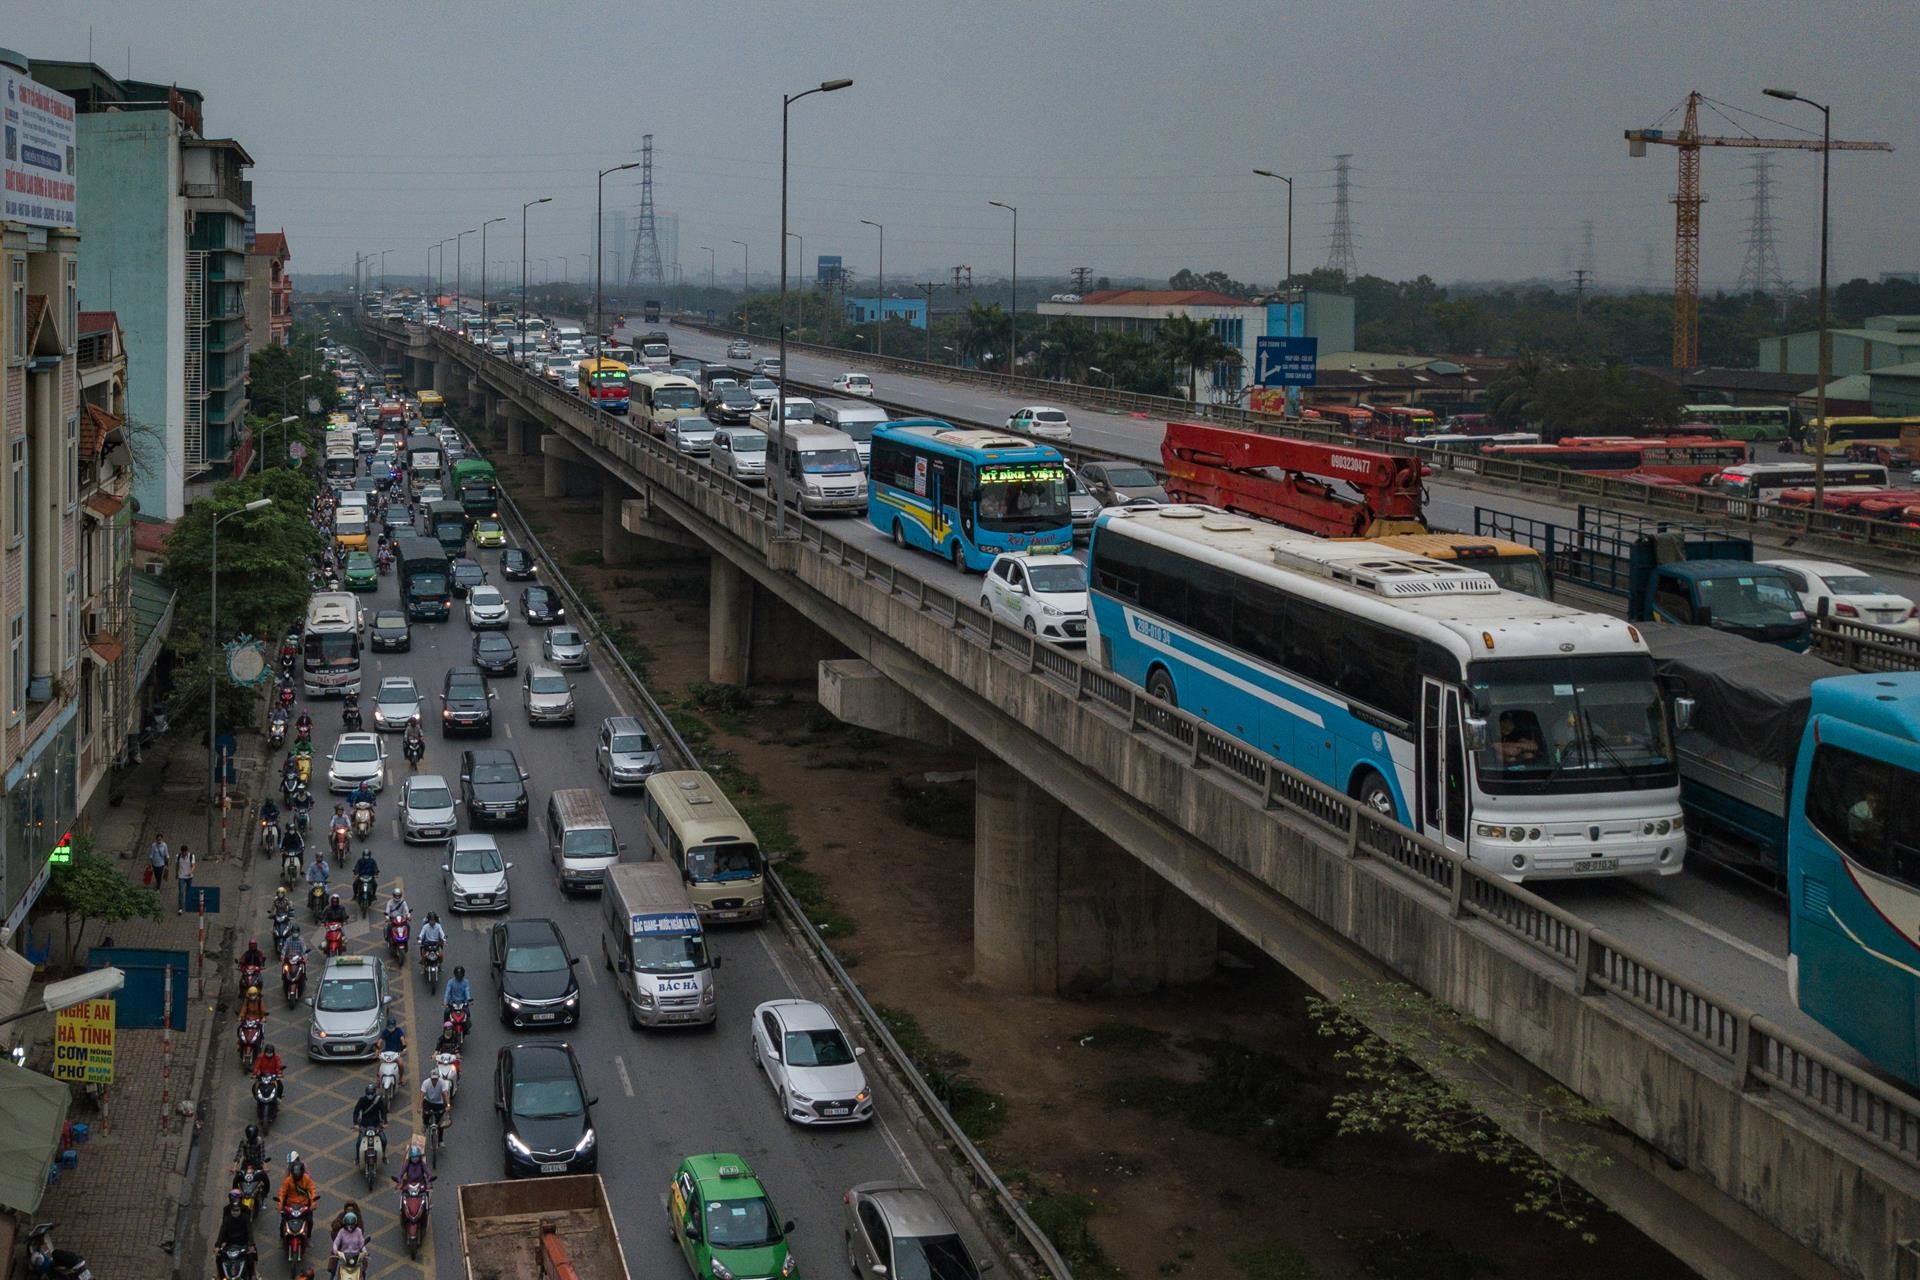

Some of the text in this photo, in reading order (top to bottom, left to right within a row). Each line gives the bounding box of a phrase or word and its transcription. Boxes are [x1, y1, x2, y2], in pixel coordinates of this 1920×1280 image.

[659, 979, 698, 992] BẮC HÀ
[94, 1004, 110, 1021] AN
[58, 1022, 112, 1046] HÀ TĨNH
[57, 1045, 88, 1061] CƠM
[57, 1061, 86, 1078] PHỞ
